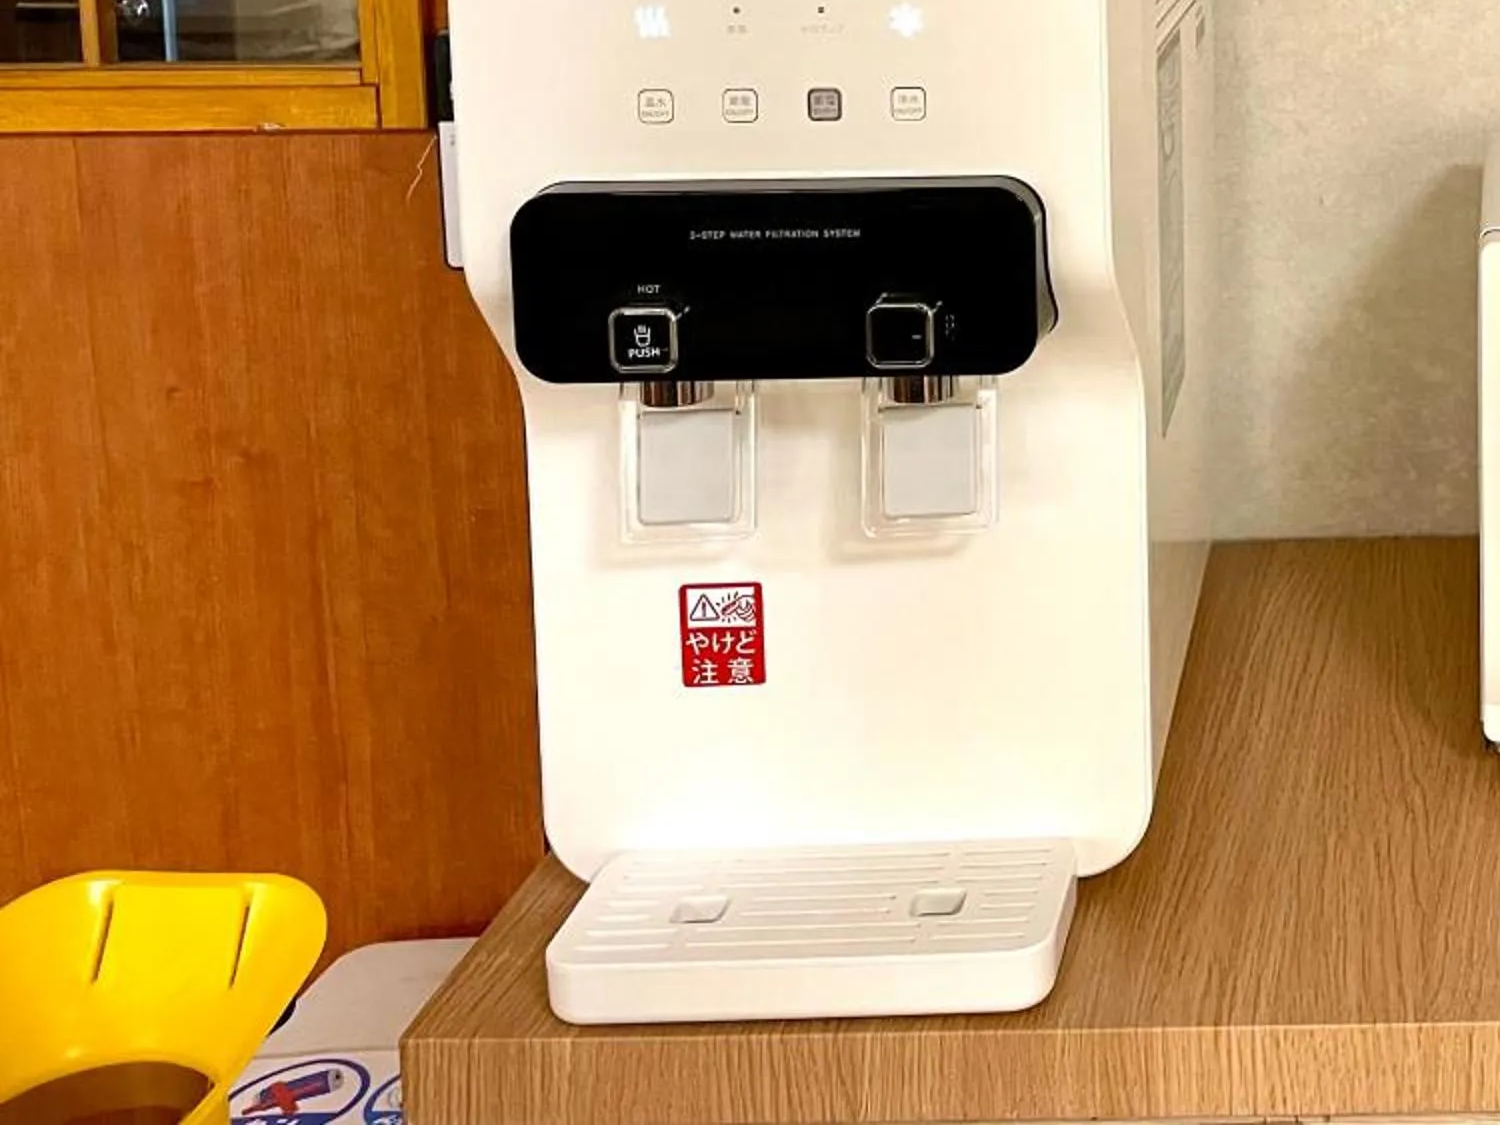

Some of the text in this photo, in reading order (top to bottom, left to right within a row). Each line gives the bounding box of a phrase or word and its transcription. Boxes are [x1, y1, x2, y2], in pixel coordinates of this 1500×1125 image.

[729, 229, 762, 239] WATER
[765, 229, 819, 239] FILTRATION
[823, 228, 861, 238] SYSTEM
[637, 284, 661, 294] HOT
[627, 346, 661, 358] PUSH
[685, 629, 757, 655] やけど
[691, 657, 755, 684] 注意
